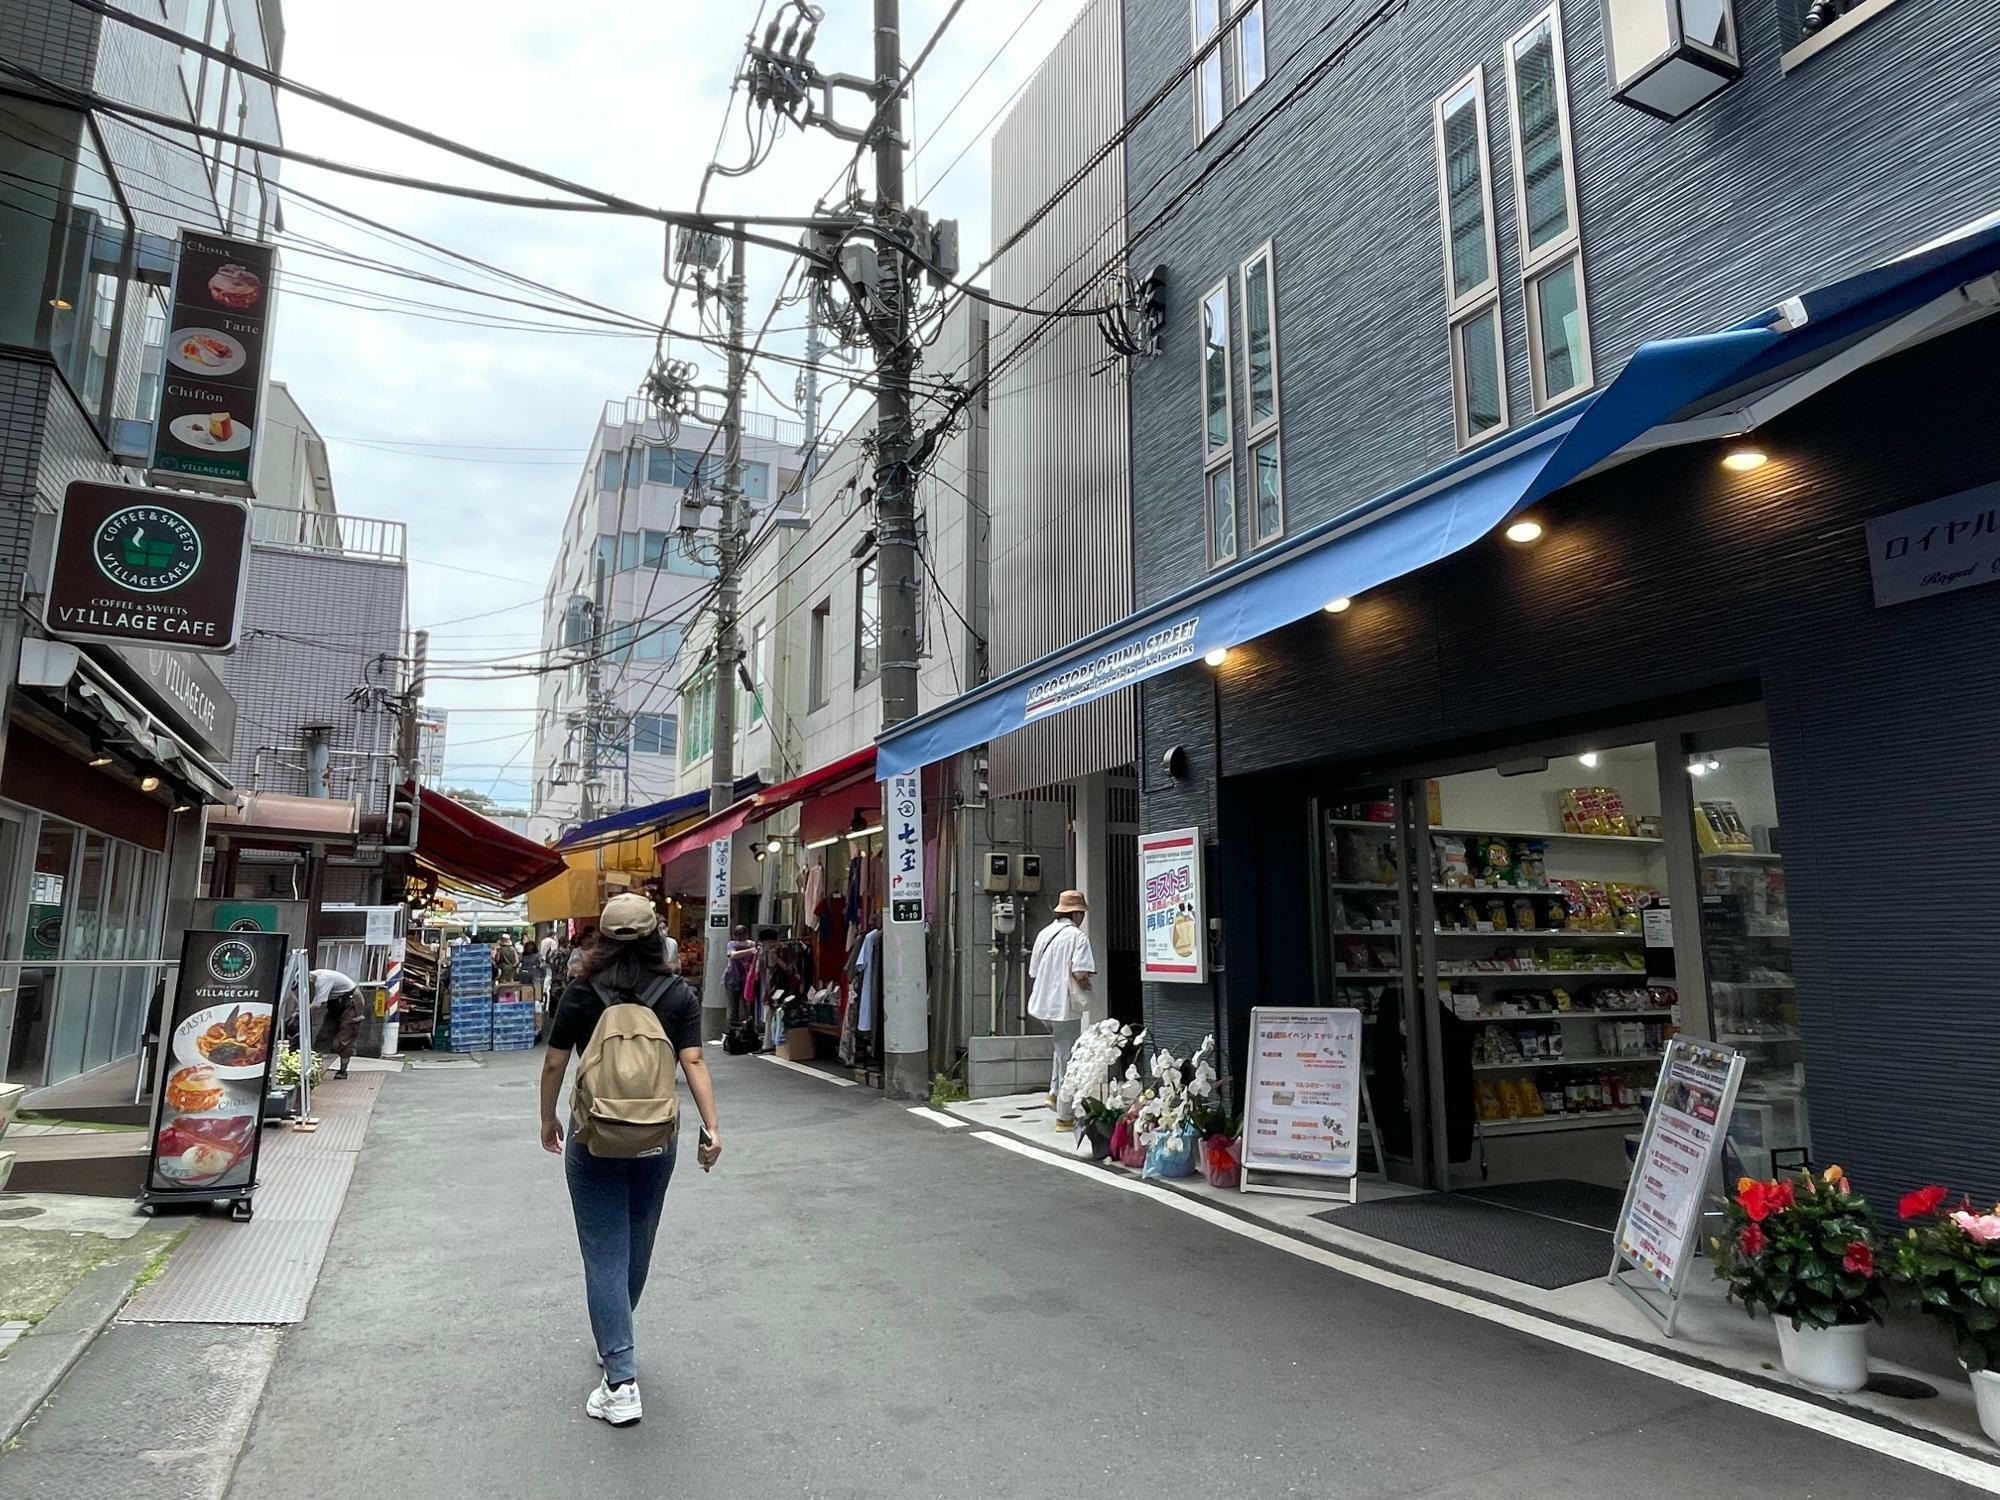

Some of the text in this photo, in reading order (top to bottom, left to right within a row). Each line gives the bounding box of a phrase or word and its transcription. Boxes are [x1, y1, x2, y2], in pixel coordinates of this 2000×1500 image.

[186, 240, 231, 257] Choux
[223, 319, 260, 334] Tarte
[168, 384, 223, 403] Chiffon
[182, 463, 241, 477] VILLAGE CAFE
[103, 511, 194, 552] COFFEE & SWEETS
[103, 552, 190, 586] VILLAGE CAFE
[1920, 562, 1979, 586] Royal
[91, 598, 134, 611] COFFEE
[146, 604, 188, 616] SWEETS
[59, 606, 216, 637] VILLAGE CAFE
[1096, 642, 1142, 675] OFUNA
[1145, 617, 1199, 656] STREET
[165, 652, 216, 732] VILLAGE CAFE
[898, 823, 918, 872] 七宝
[1146, 865, 1190, 903] コストコ
[196, 989, 259, 998] VILLAGE CAFE
[179, 1010, 213, 1037] PASTA
